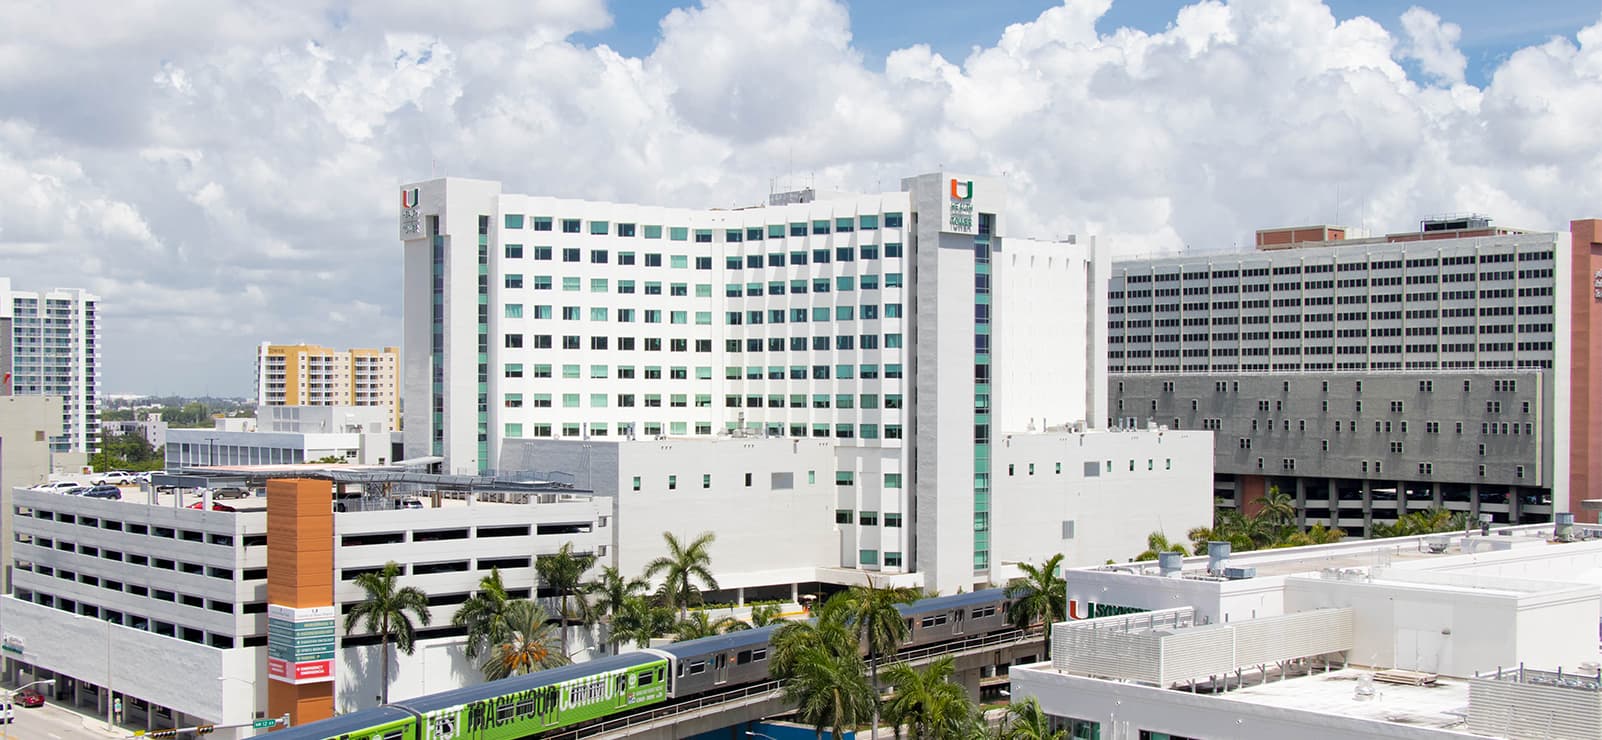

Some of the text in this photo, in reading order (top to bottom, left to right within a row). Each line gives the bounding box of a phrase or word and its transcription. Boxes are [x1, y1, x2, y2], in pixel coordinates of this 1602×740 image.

[466, 693, 515, 733] TRACK
[518, 684, 559, 722] YOUR
[559, 670, 628, 712] COMMUTE
